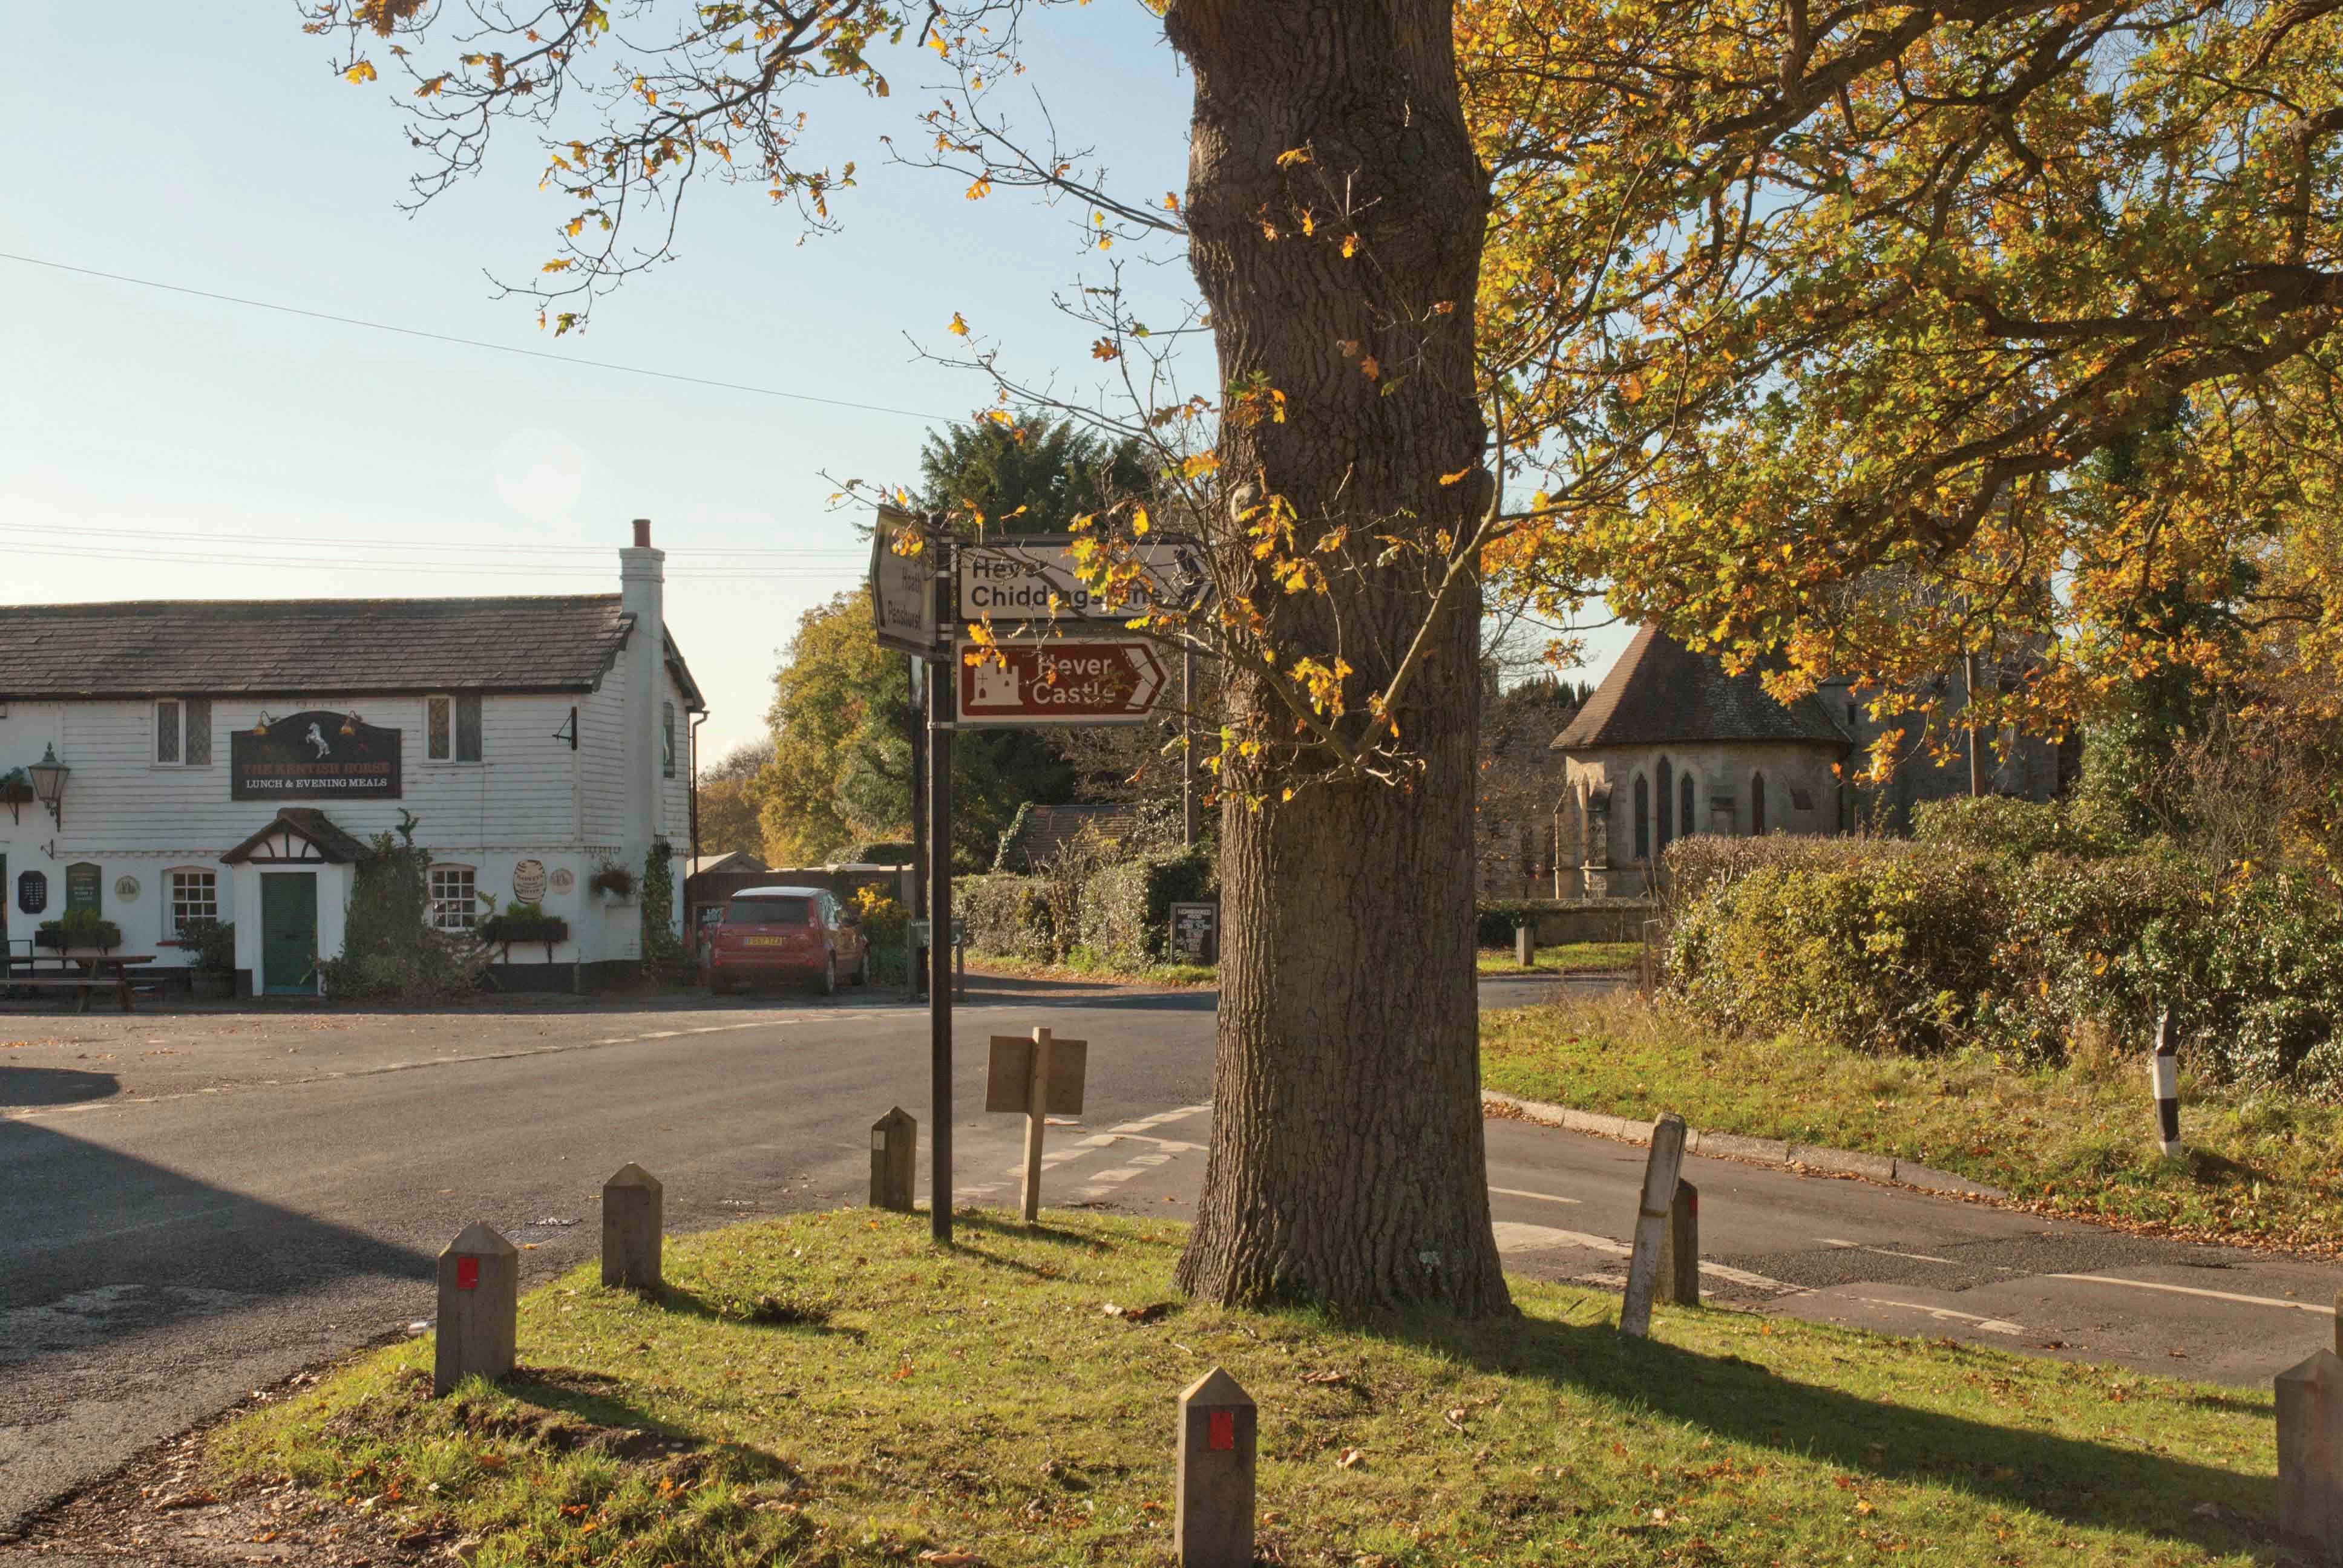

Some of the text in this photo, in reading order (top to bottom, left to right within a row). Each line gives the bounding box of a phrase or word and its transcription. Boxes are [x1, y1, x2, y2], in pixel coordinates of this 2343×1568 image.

[902, 566, 921, 593] Hoath
[888, 600, 921, 630] Penshurst
[1038, 654, 1112, 675] Hever
[1032, 682, 1116, 704] Castle
[243, 762, 390, 774] THE KENTISH HORSE
[246, 777, 387, 788] LUNCH & EVENING MEALS
